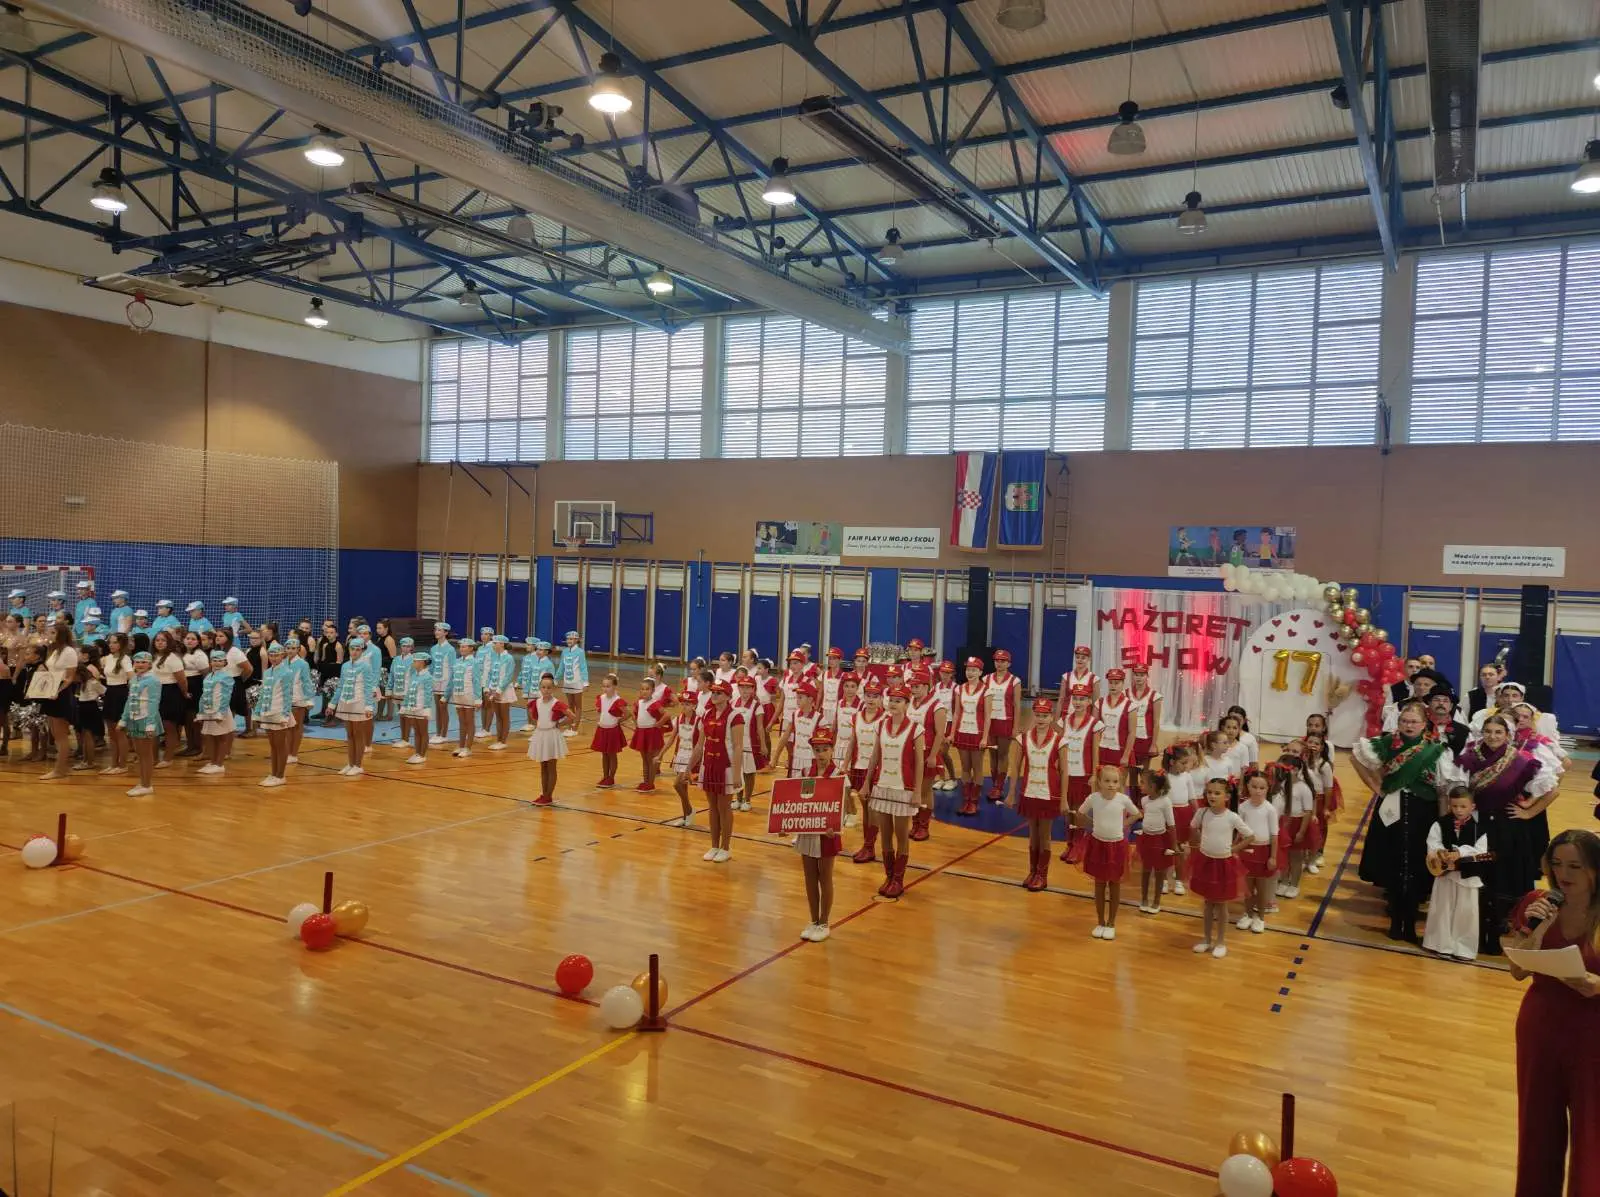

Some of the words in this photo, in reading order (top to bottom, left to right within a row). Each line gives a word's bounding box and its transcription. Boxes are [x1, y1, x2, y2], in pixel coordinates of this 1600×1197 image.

[1096, 602, 1251, 641] MAŽORET
[1120, 644, 1232, 676] SHOW
[1270, 648, 1323, 696] 17
[772, 800, 840, 814] MAŽORETKINJE
[781, 816, 827, 830] KOTORIBE
